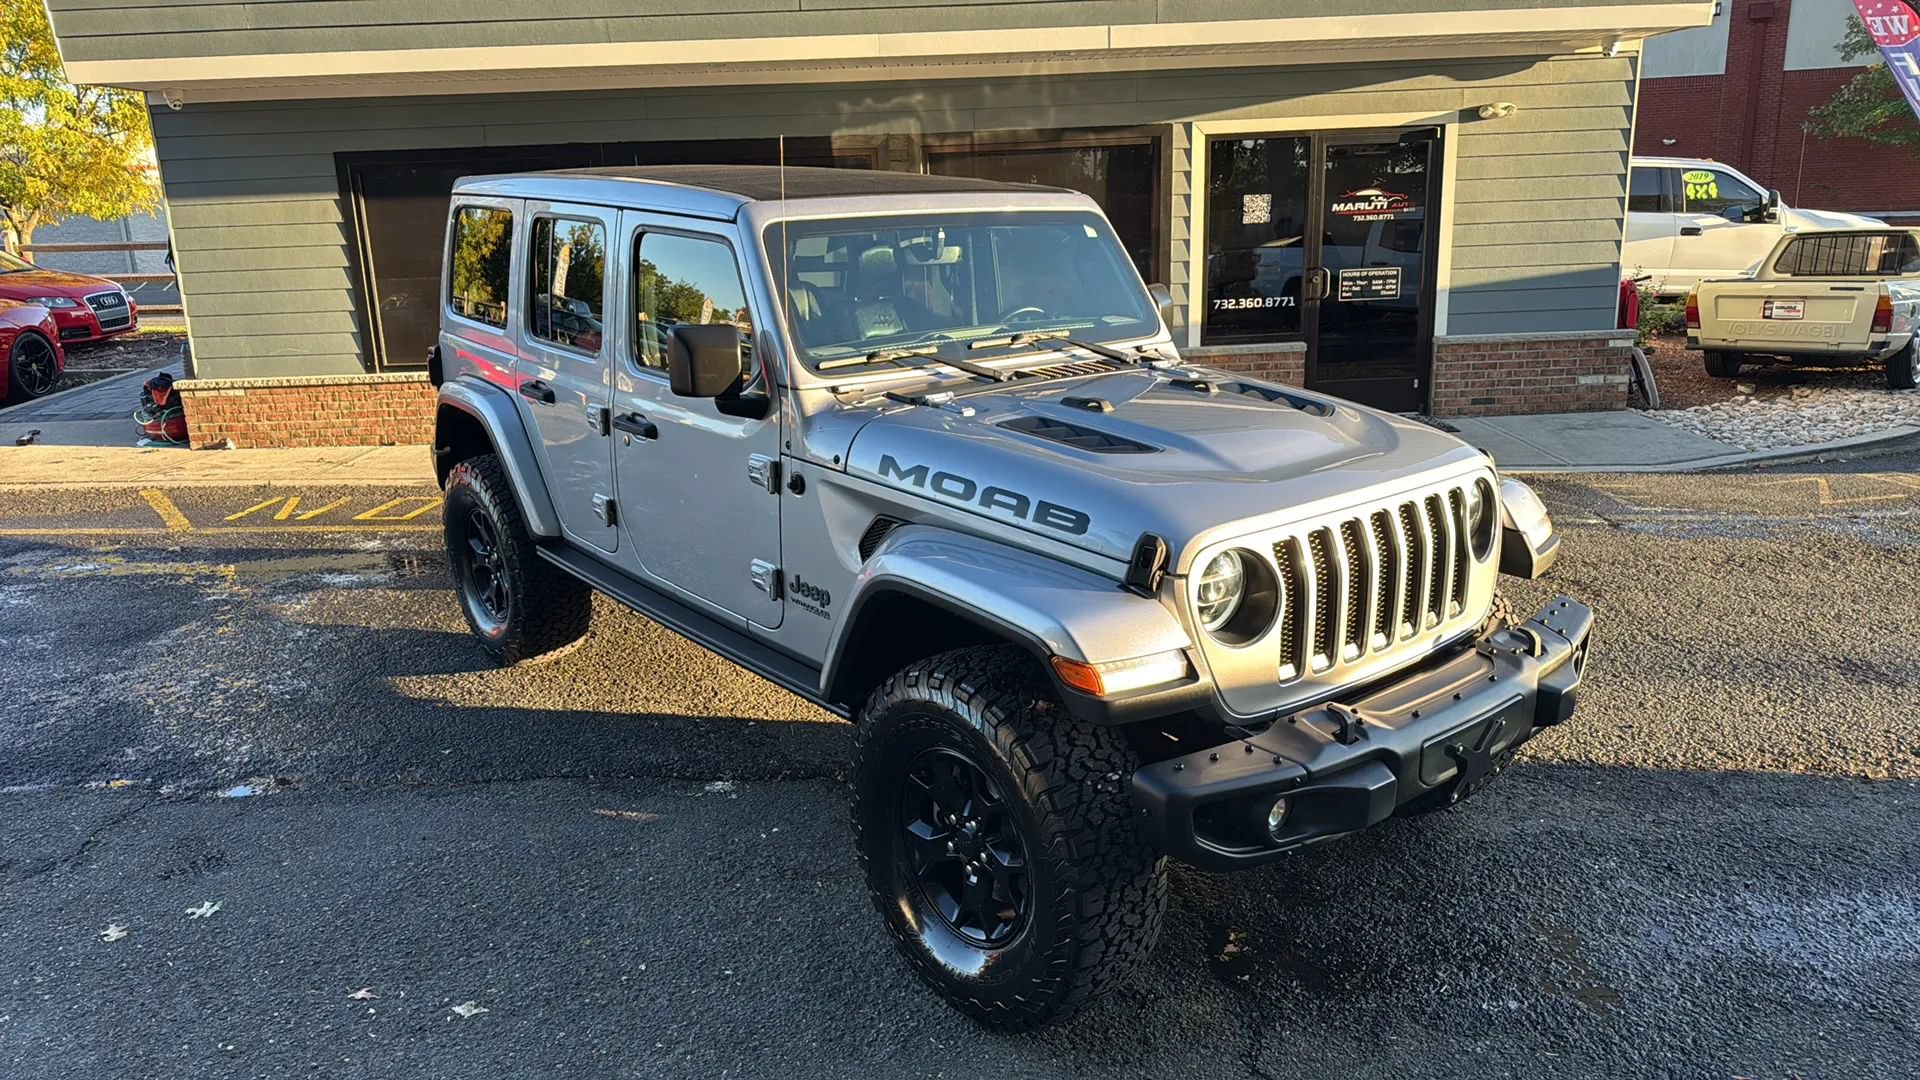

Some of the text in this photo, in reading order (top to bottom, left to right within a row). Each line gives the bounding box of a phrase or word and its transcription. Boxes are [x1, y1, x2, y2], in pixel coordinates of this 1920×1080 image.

[1688, 172, 1709, 181] 2019
[1332, 202, 1388, 212] MARUTI
[1213, 296, 1295, 310] 732.360.8771
[1727, 322, 1845, 338] VOLKSWAGEN
[877, 453, 1091, 536] MOAB
[789, 574, 831, 609] Jeep
